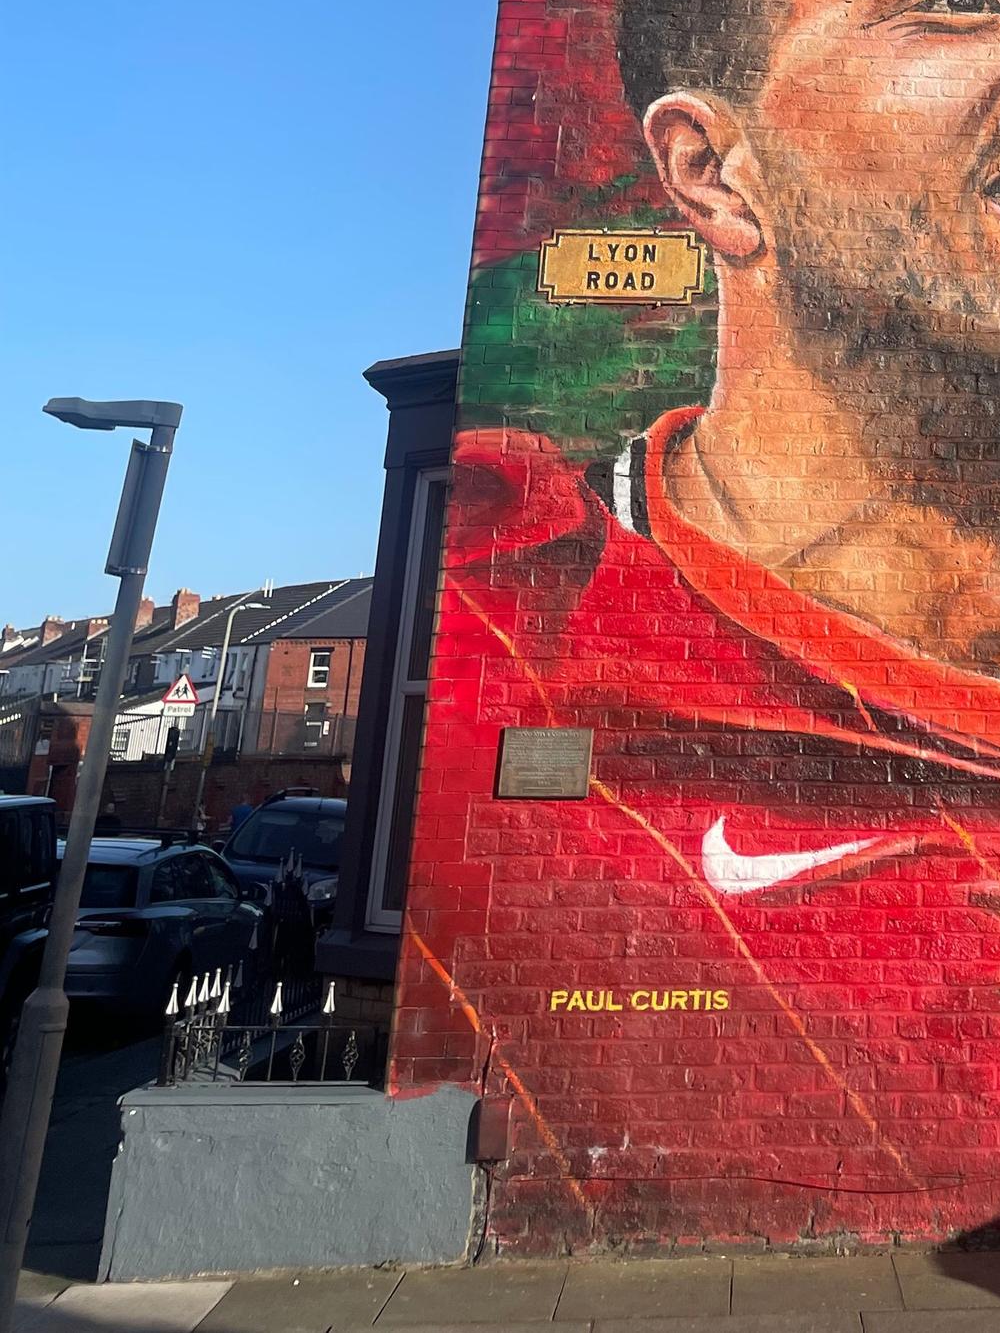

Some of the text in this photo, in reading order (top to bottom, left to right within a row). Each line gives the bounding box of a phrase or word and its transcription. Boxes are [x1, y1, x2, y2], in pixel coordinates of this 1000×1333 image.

[588, 244, 657, 262] LYON
[586, 271, 656, 291] ROAD
[550, 989, 730, 1012] PAUL CURTIS
